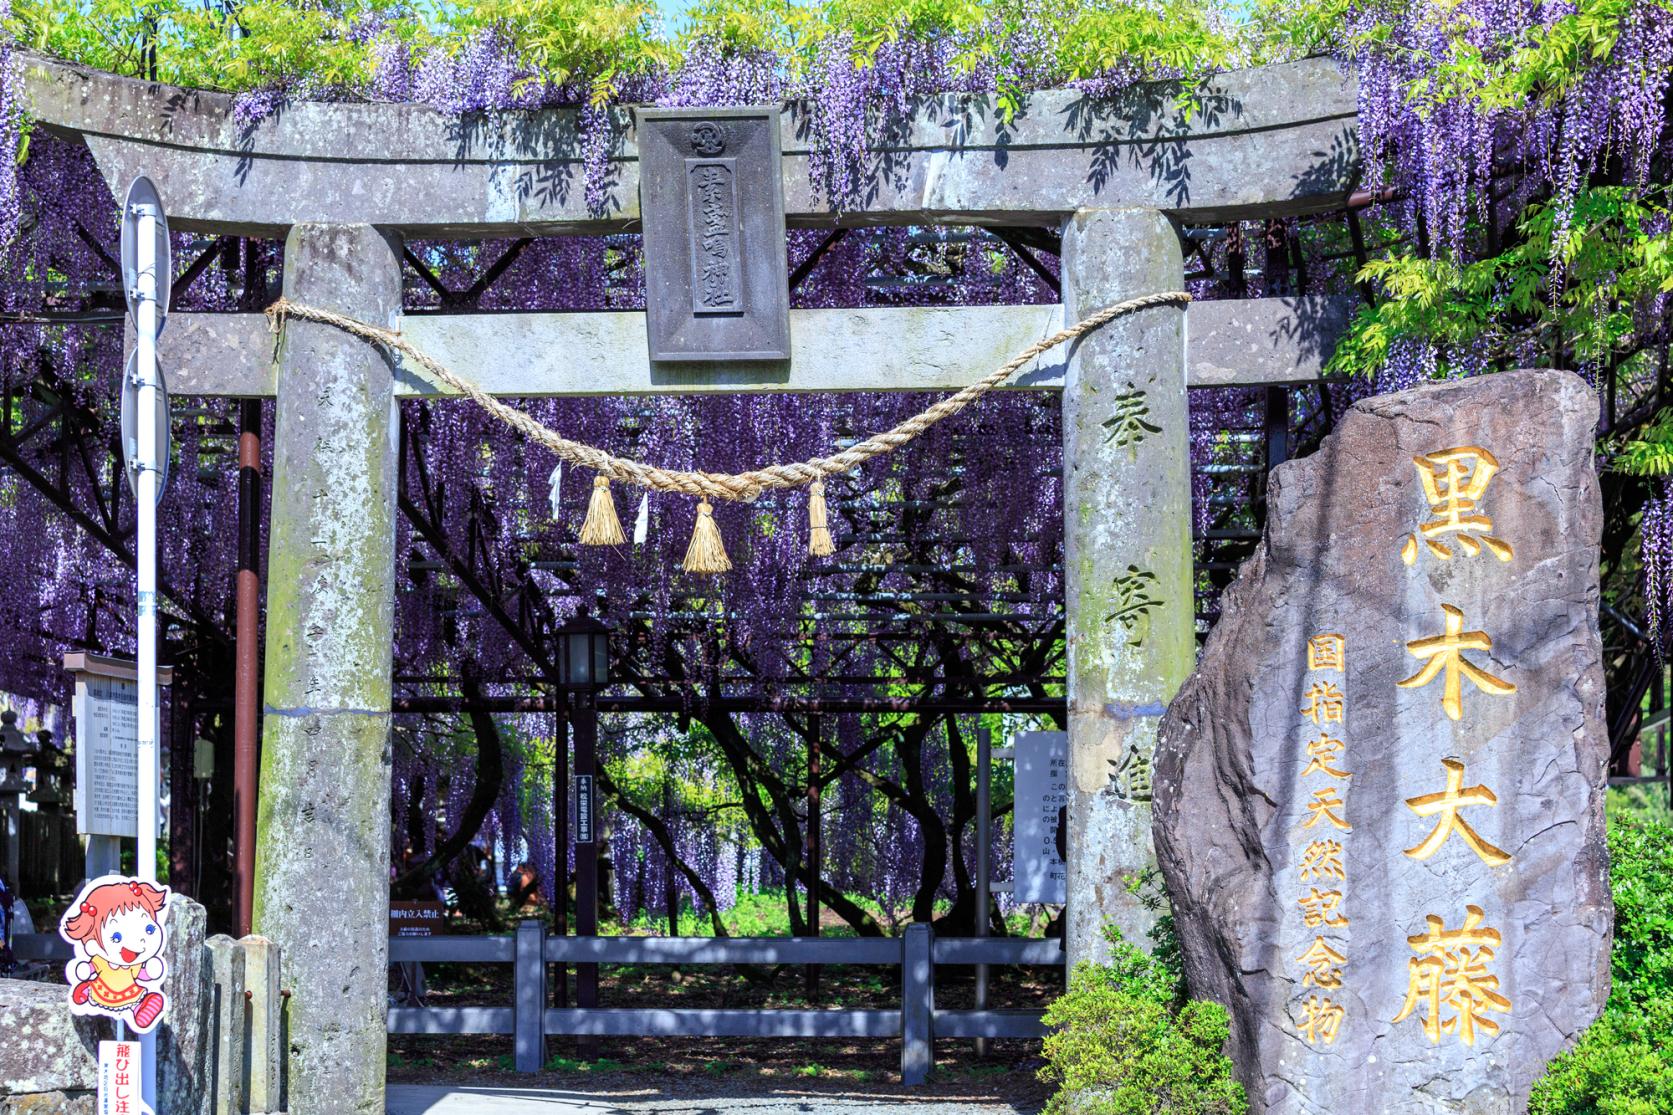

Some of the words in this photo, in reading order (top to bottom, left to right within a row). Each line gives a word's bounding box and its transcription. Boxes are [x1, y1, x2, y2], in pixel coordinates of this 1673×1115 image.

[1298, 632, 1352, 1045] 国指定天然記念物
[1392, 447, 1517, 1046] 黒木大藤
